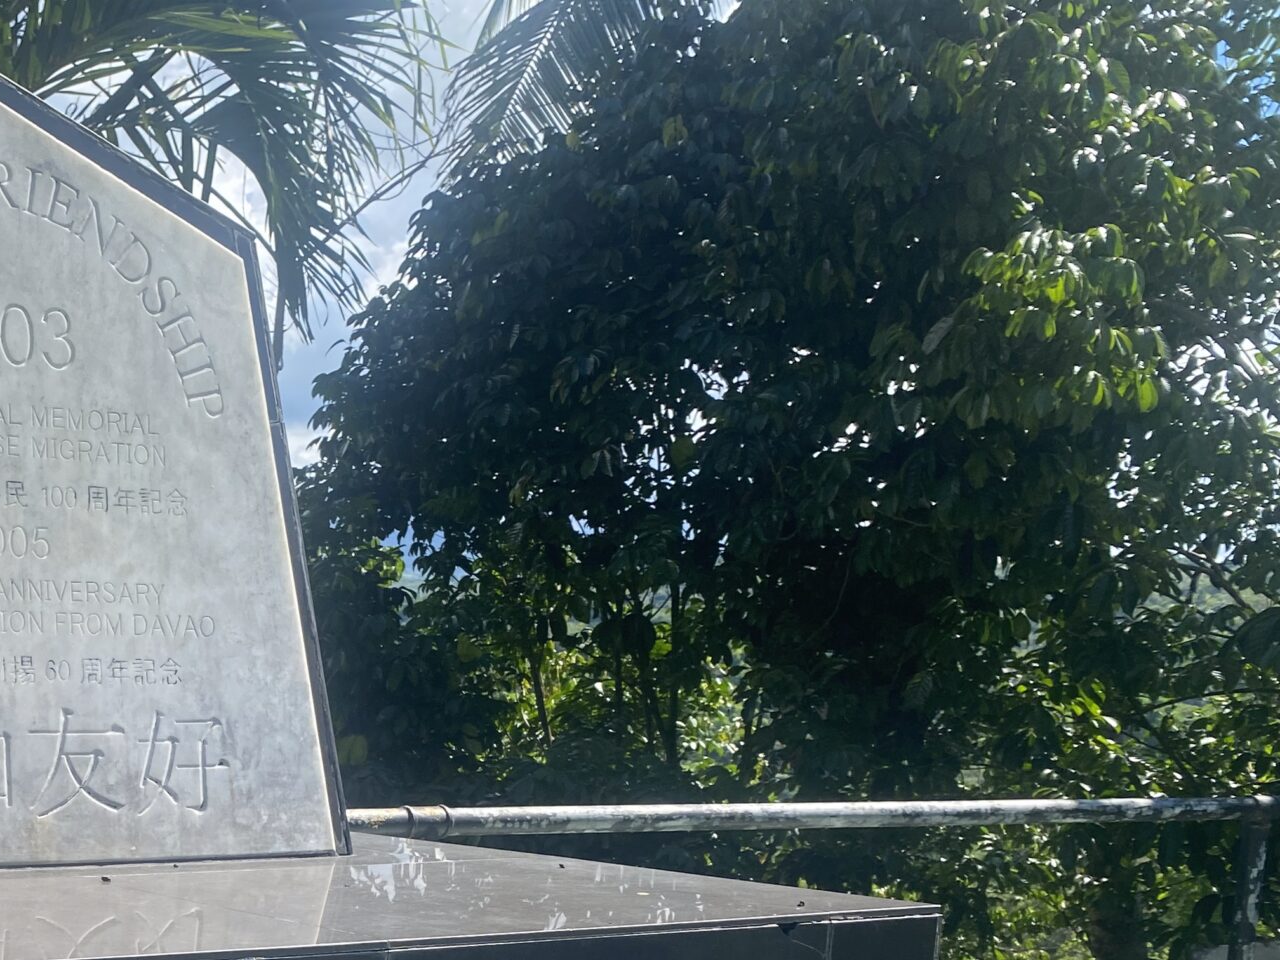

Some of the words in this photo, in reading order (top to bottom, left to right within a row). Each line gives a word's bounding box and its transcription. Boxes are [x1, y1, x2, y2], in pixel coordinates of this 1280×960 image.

[31, 405, 160, 436] MEMORIAL
[32, 437, 167, 467] MIGRATION
[55, 612, 121, 638] FROM
[134, 613, 216, 640] DAVAO
